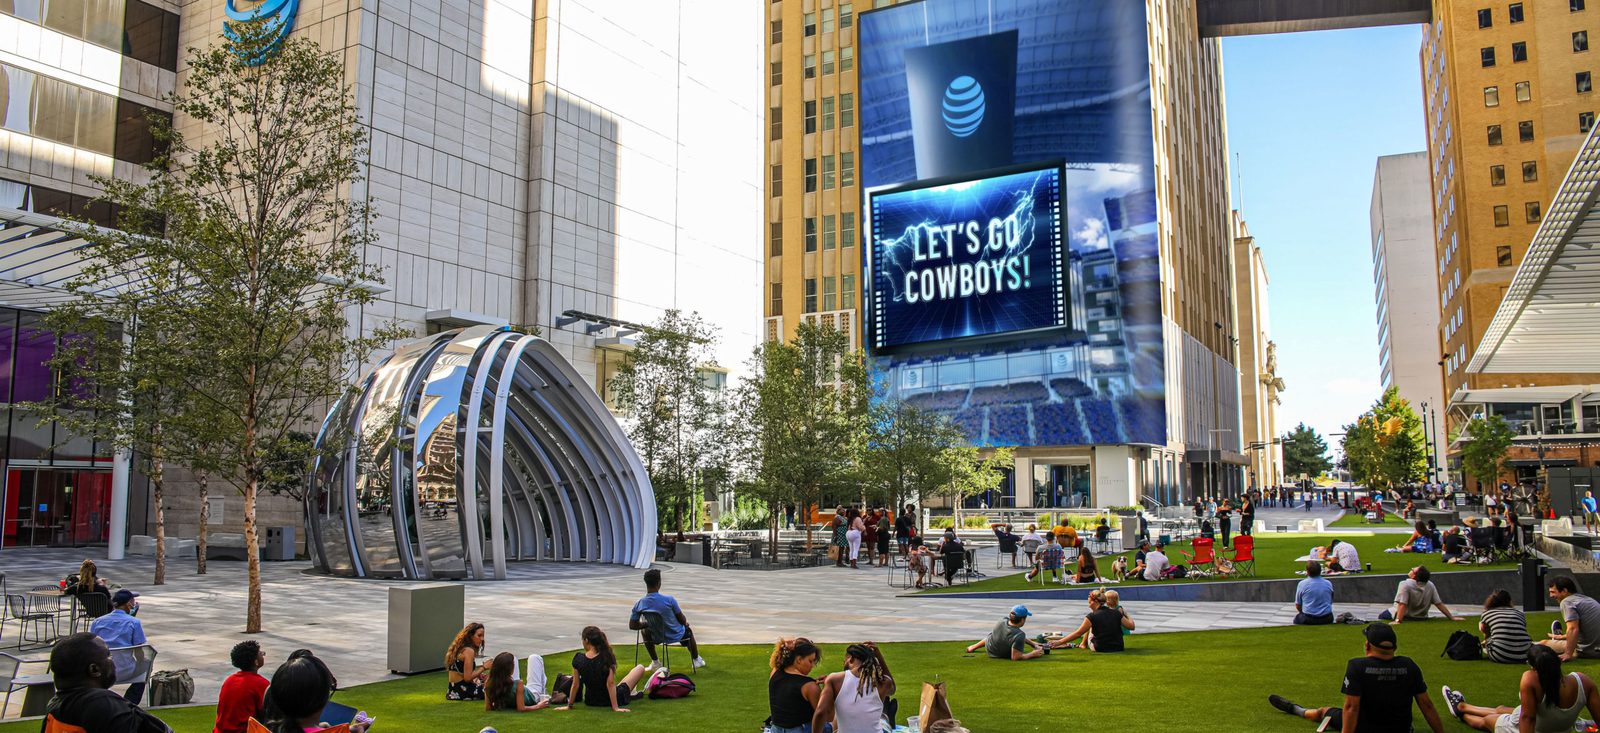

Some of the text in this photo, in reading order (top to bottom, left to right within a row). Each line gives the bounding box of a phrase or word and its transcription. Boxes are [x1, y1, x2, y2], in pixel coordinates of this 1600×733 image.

[914, 214, 1019, 262] LET'S GO
[905, 255, 1031, 303] COWBOYS!
